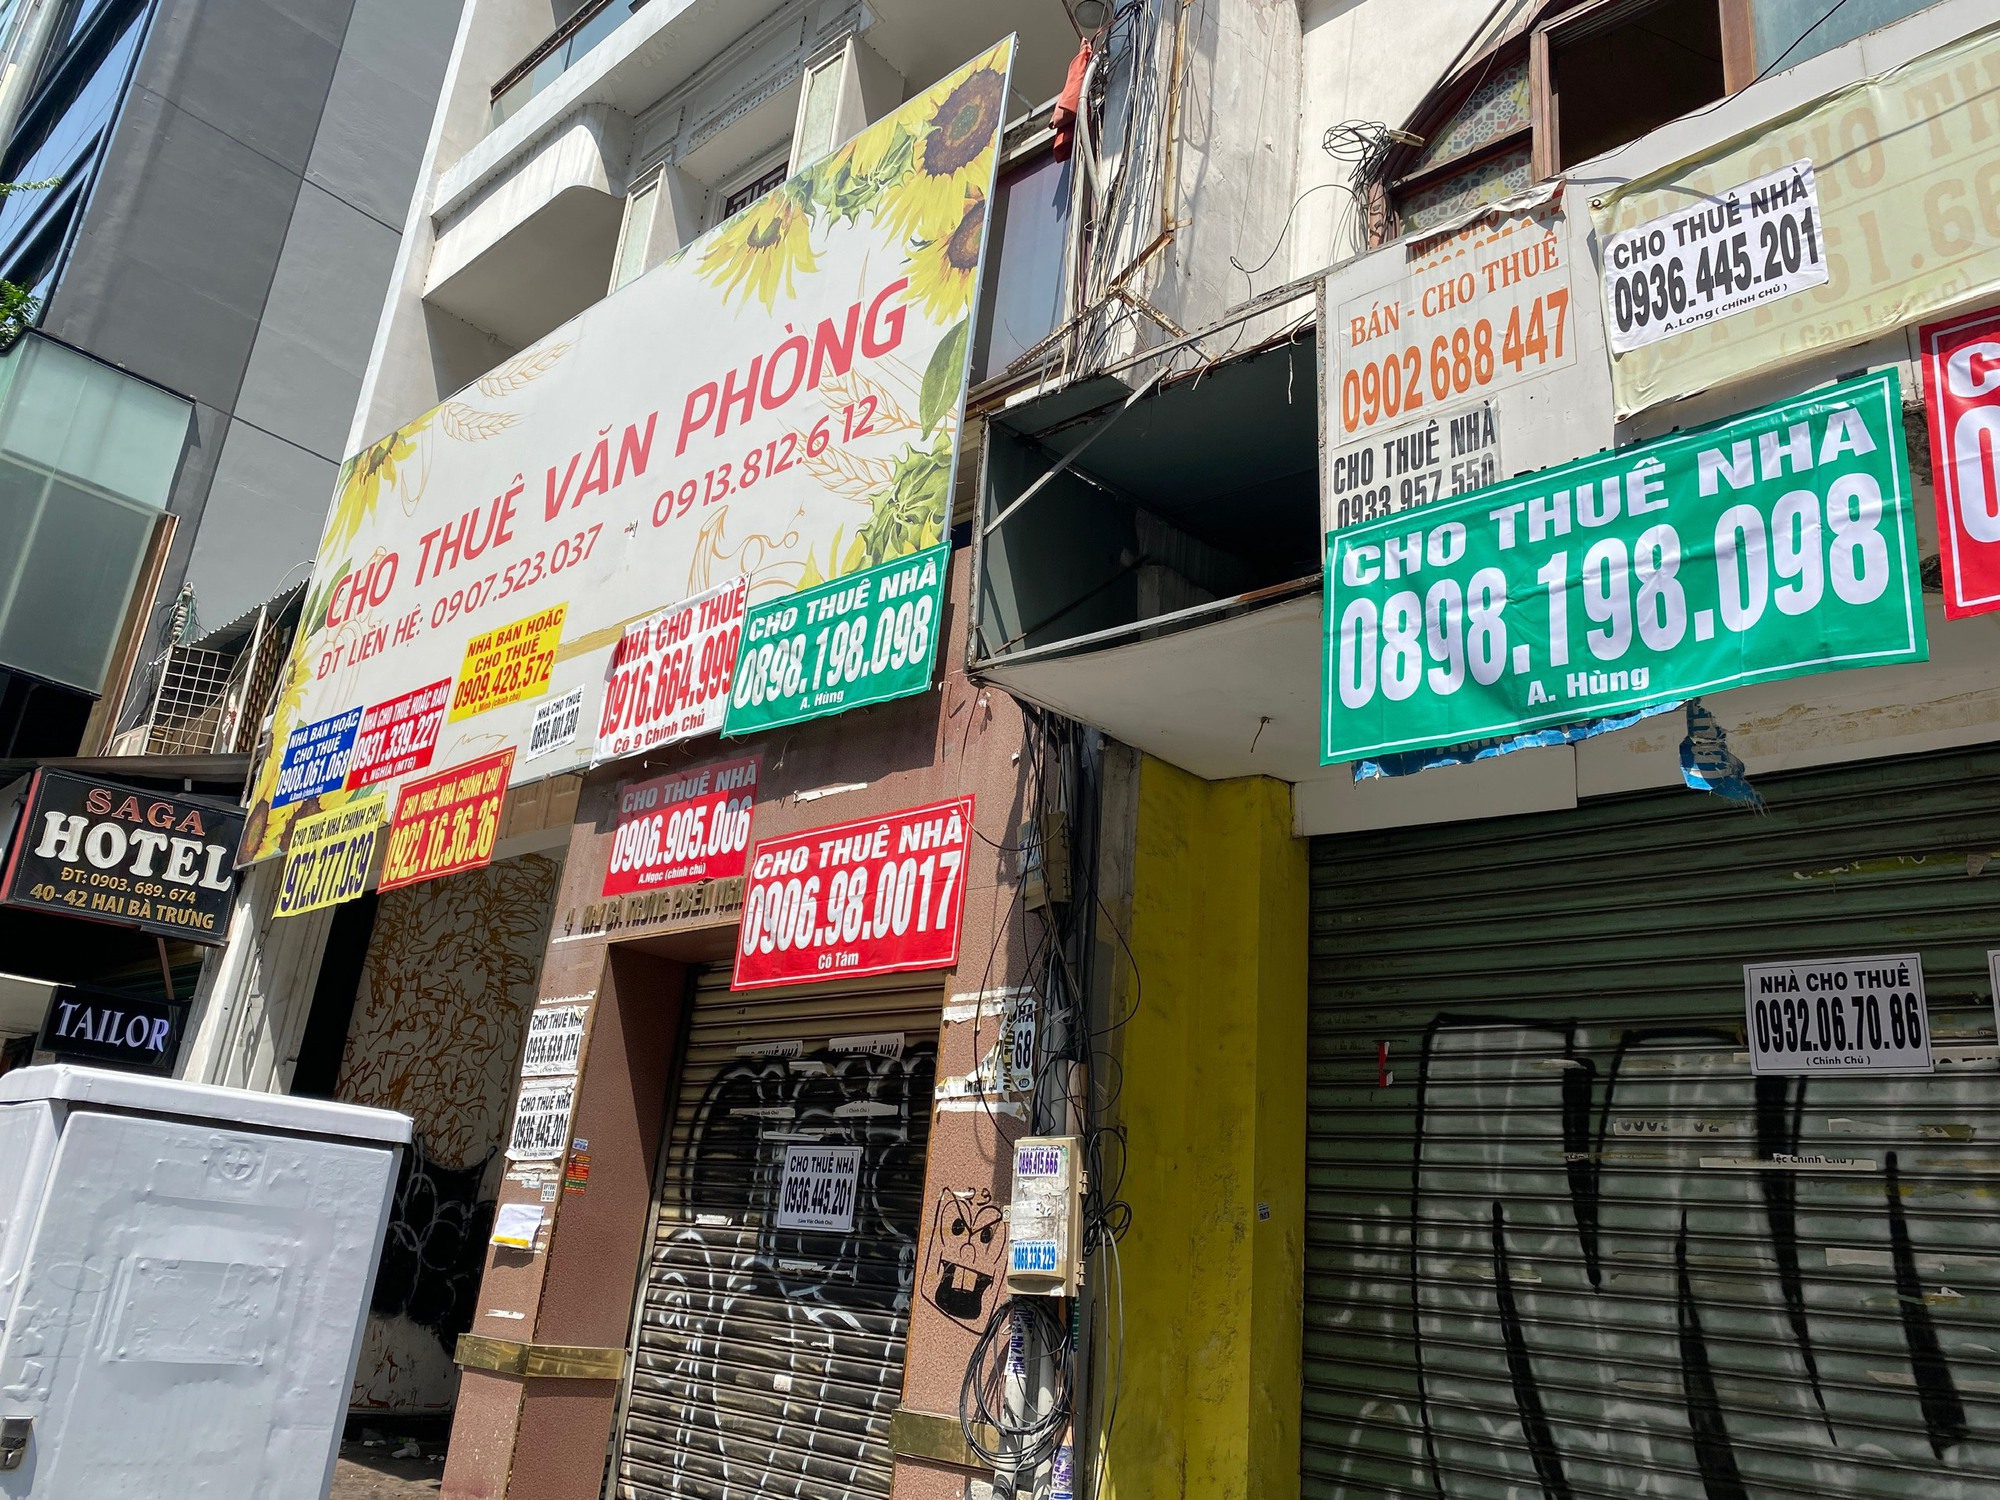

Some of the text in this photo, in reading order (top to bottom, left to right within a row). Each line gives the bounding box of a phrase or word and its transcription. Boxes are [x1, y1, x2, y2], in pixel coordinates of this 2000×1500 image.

[1613, 230, 1665, 270] CHO
[1673, 192, 1742, 249] THUÊ
[1750, 166, 1809, 219] NHÀ
[1350, 300, 1399, 348] BÁN
[1421, 272, 1475, 318] CHO
[1482, 230, 1559, 294] THUÊ
[1615, 206, 1819, 334] 0936.445.201
[1663, 308, 1714, 333] A.Long
[325, 276, 910, 629] CHO THUÊ VĂN PHÒNG
[1334, 447, 1373, 495] CHO
[1383, 420, 1439, 480] THUÊ
[1450, 399, 1497, 459] NHÀ
[1342, 522, 1466, 587] CHO
[1488, 456, 1670, 551] THUÊ
[316, 650, 339, 681] ĐT
[346, 621, 388, 667] LIÊN
[391, 604, 424, 649] HỆ:
[430, 522, 603, 630] 0907.523.037
[748, 557, 937, 643] CHO THUÊ NHÀ
[1339, 473, 1890, 710] 0898.198.098
[467, 608, 563, 658] NHÀ BÁN HOẶC
[613, 580, 747, 670] NHÀ CHO THUÊ
[475, 633, 541, 673] CHO THUÊ
[734, 594, 932, 710] 0898.198.098
[453, 649, 554, 711] 0909.428.572
[598, 623, 741, 740] 0916.664.999
[799, 689, 844, 711] A. Hùng
[1527, 666, 1650, 706] A. Hùng
[289, 712, 359, 749] NHÀ BÁN HOẶC
[362, 682, 450, 733] NHÀ CHO THUÊ HOẶC BÁN
[551, 698, 564, 715] CHO
[612, 706, 705, 754] Cô 9 Chính Chủ
[293, 733, 341, 764] CHO THUÊ
[352, 709, 443, 771] 0931.339.227
[275, 748, 350, 797] 0908.061.068
[361, 772, 368, 784] A.
[393, 755, 416, 776] (MTG)
[400, 757, 505, 820] CHO THUÊ NHÀ CHÍNH CHỦ
[621, 759, 757, 814] CHO THUÊ NHÀ
[86, 788, 206, 836] SAGA
[292, 796, 384, 848] CHO THUÊ NHÀ CHÍNH CHỦ
[610, 795, 753, 874] 0906.905.006
[34, 811, 233, 892] HOTEL
[754, 809, 963, 881] CHO THUÊ NHÀ
[60, 866, 87, 886] ĐT:
[281, 831, 374, 912] 972.377.039
[665, 866, 688, 880] (chính
[30, 883, 215, 931] 40-42 HAI BÀ TRƯNG
[743, 849, 962, 957] 0906.98.0017
[817, 950, 859, 971] Cô Tám
[1760, 963, 1911, 994] NHÀ CHO THUÊ
[57, 1000, 170, 1053] TAILOR
[532, 1014, 549, 1031] CHO
[1755, 992, 1922, 1053] 0932.06.70.86
[520, 1096, 536, 1112] CHO
[790, 1151, 854, 1174] CHO THUÊ NHÀ
[784, 1175, 853, 1217] 0936.445.201
